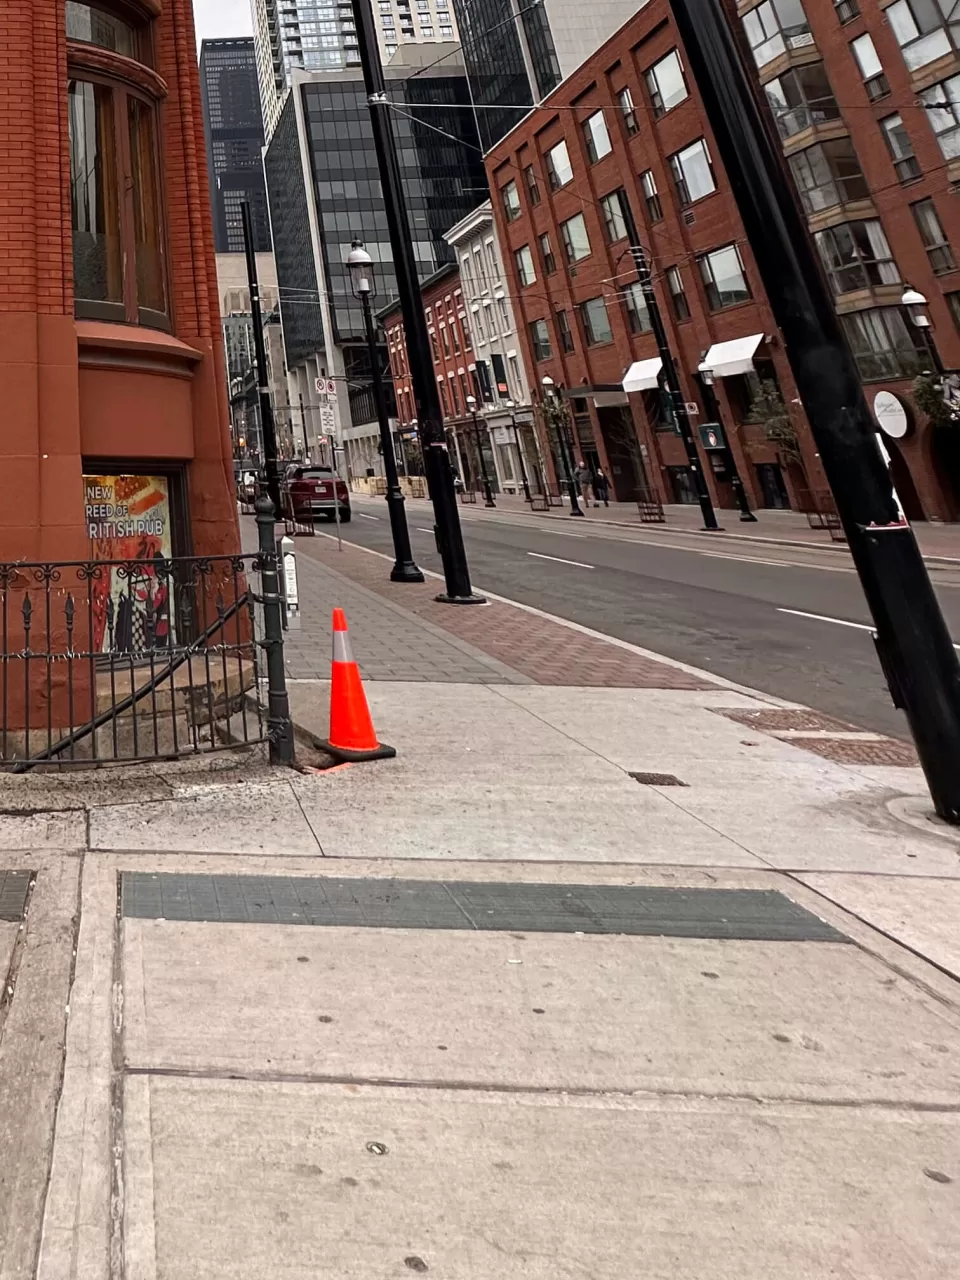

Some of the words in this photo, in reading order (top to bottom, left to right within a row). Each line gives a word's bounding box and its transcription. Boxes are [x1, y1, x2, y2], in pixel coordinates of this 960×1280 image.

[87, 486, 112, 499] NEW
[85, 504, 114, 518] REED
[116, 505, 129, 517] OF
[89, 521, 135, 539] RITISH
[138, 520, 163, 536] PUB
